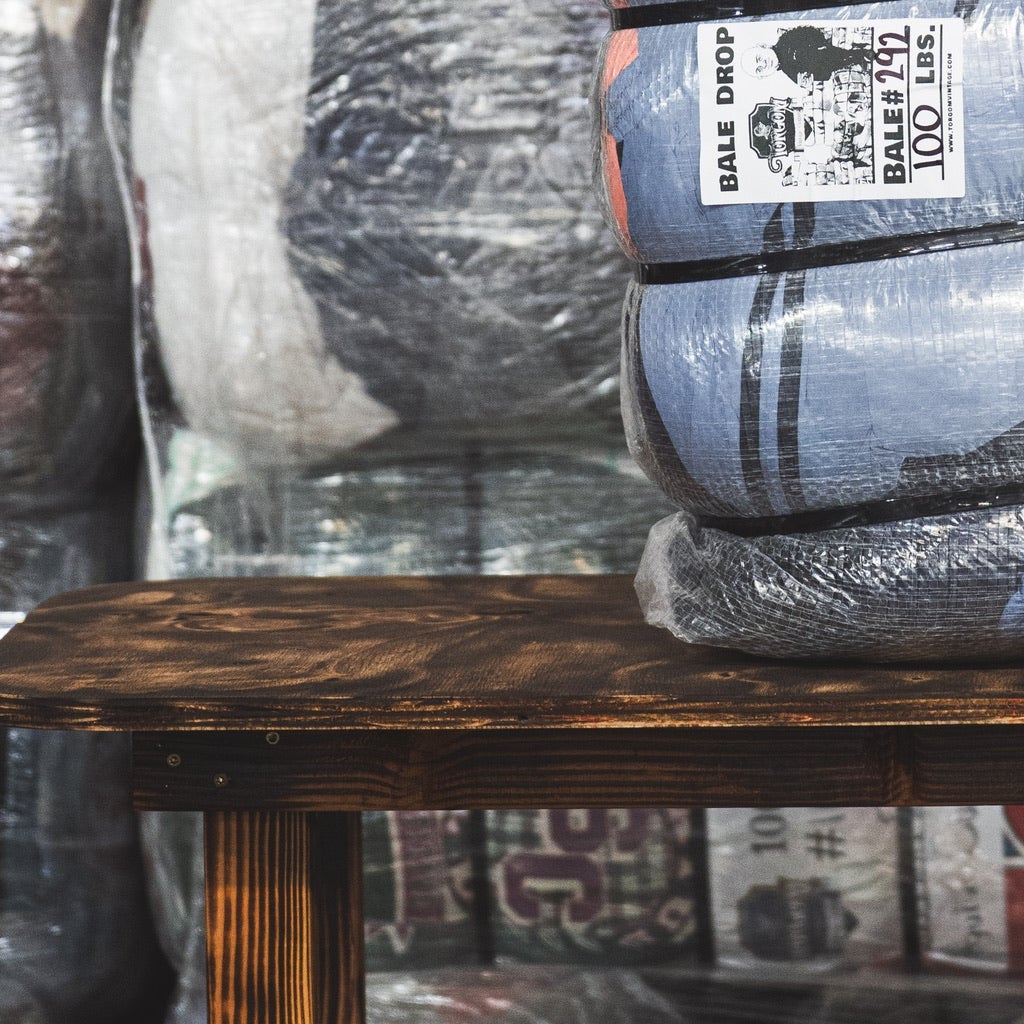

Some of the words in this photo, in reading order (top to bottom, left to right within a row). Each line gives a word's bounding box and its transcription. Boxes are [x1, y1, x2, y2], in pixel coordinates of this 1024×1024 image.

[715, 26, 735, 105] DROP
[915, 24, 936, 84] LBS.
[717, 120, 739, 192] BALE
[912, 104, 944, 170] 100
